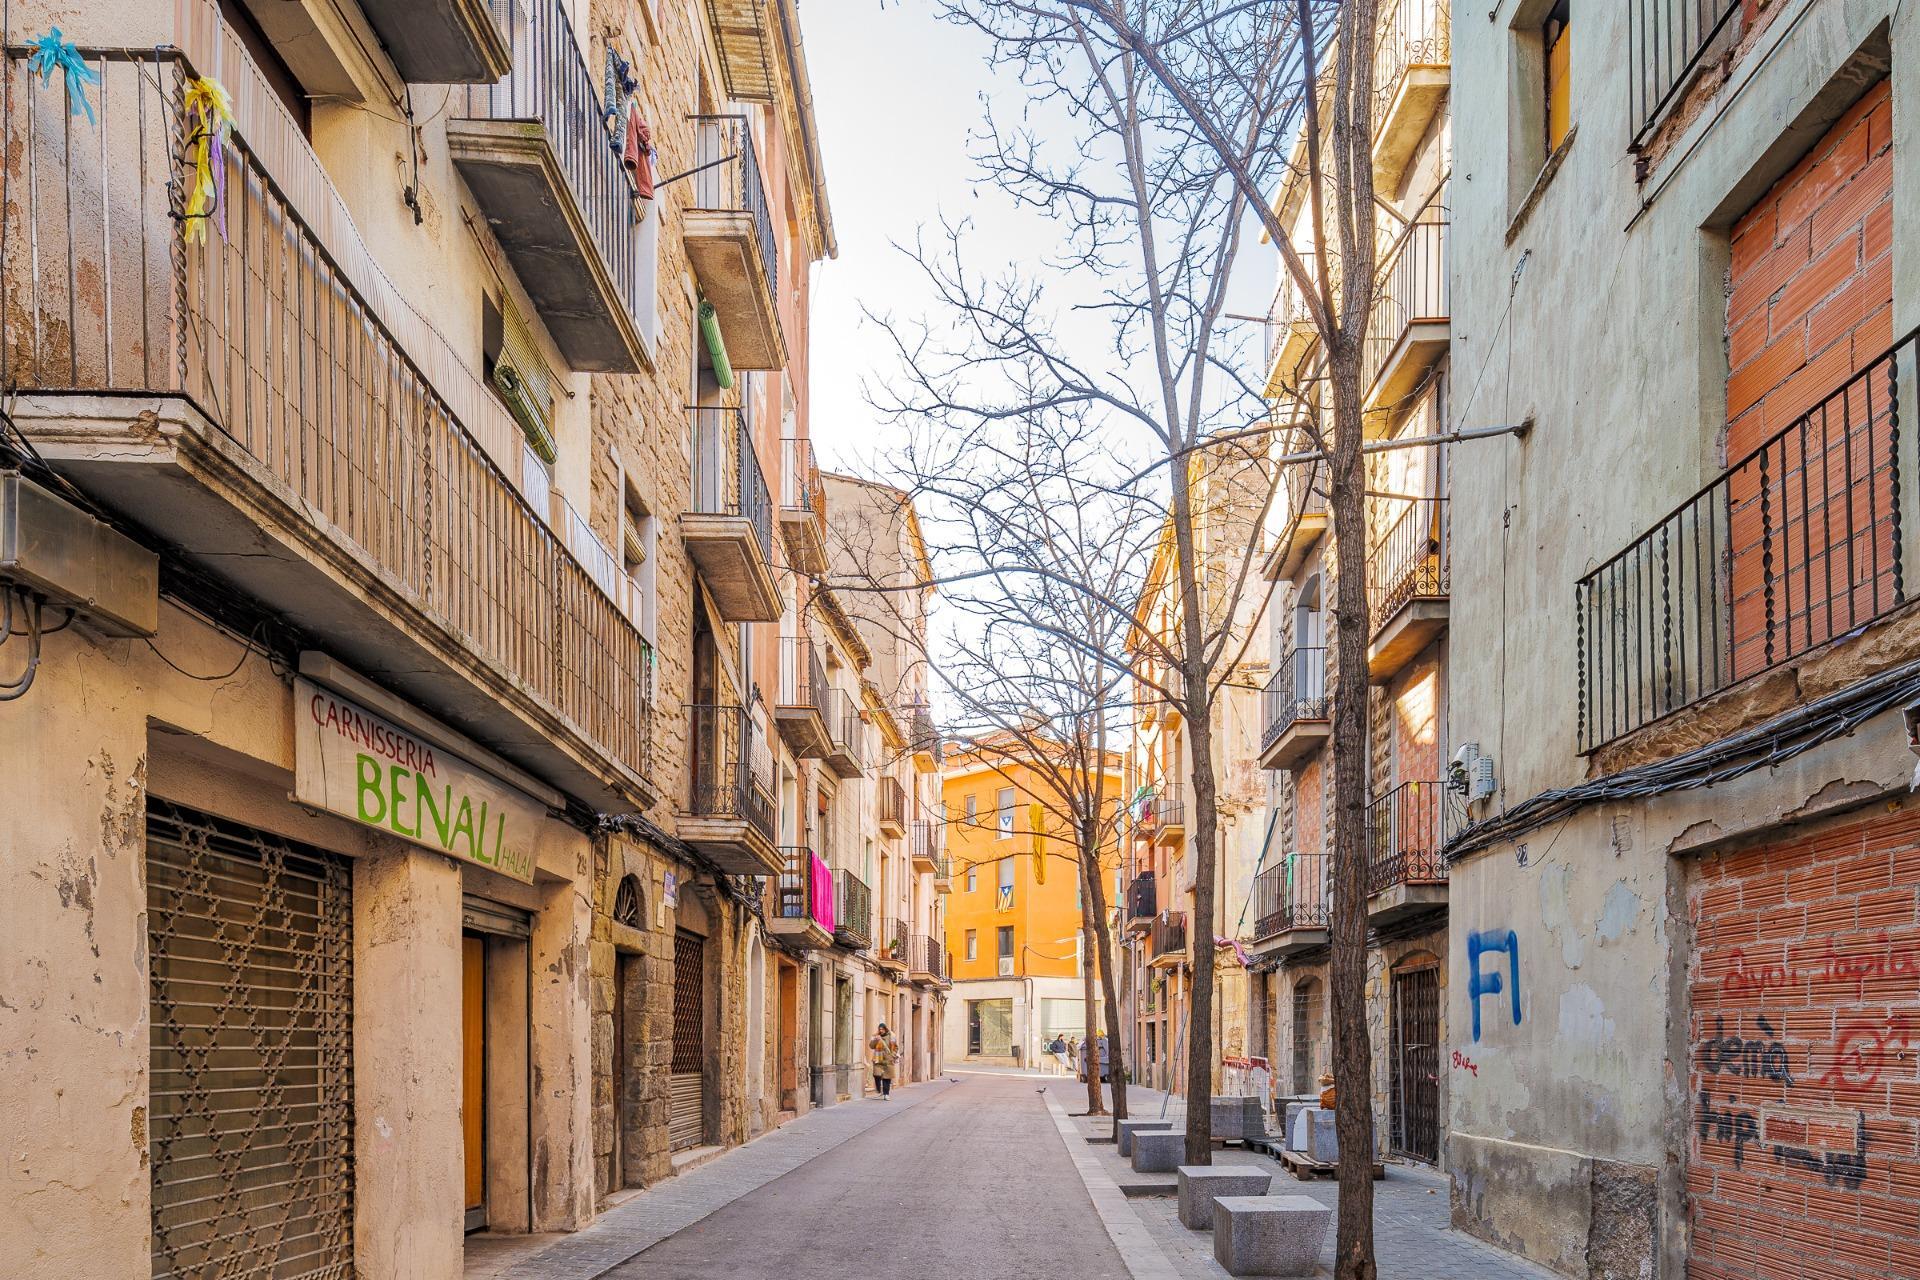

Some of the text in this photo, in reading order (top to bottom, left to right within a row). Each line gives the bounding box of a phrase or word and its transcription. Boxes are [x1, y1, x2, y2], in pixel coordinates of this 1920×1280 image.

[311, 694, 437, 778] CARNISSERIA
[356, 752, 506, 867] BENALI
[501, 846, 532, 878] HALAL
